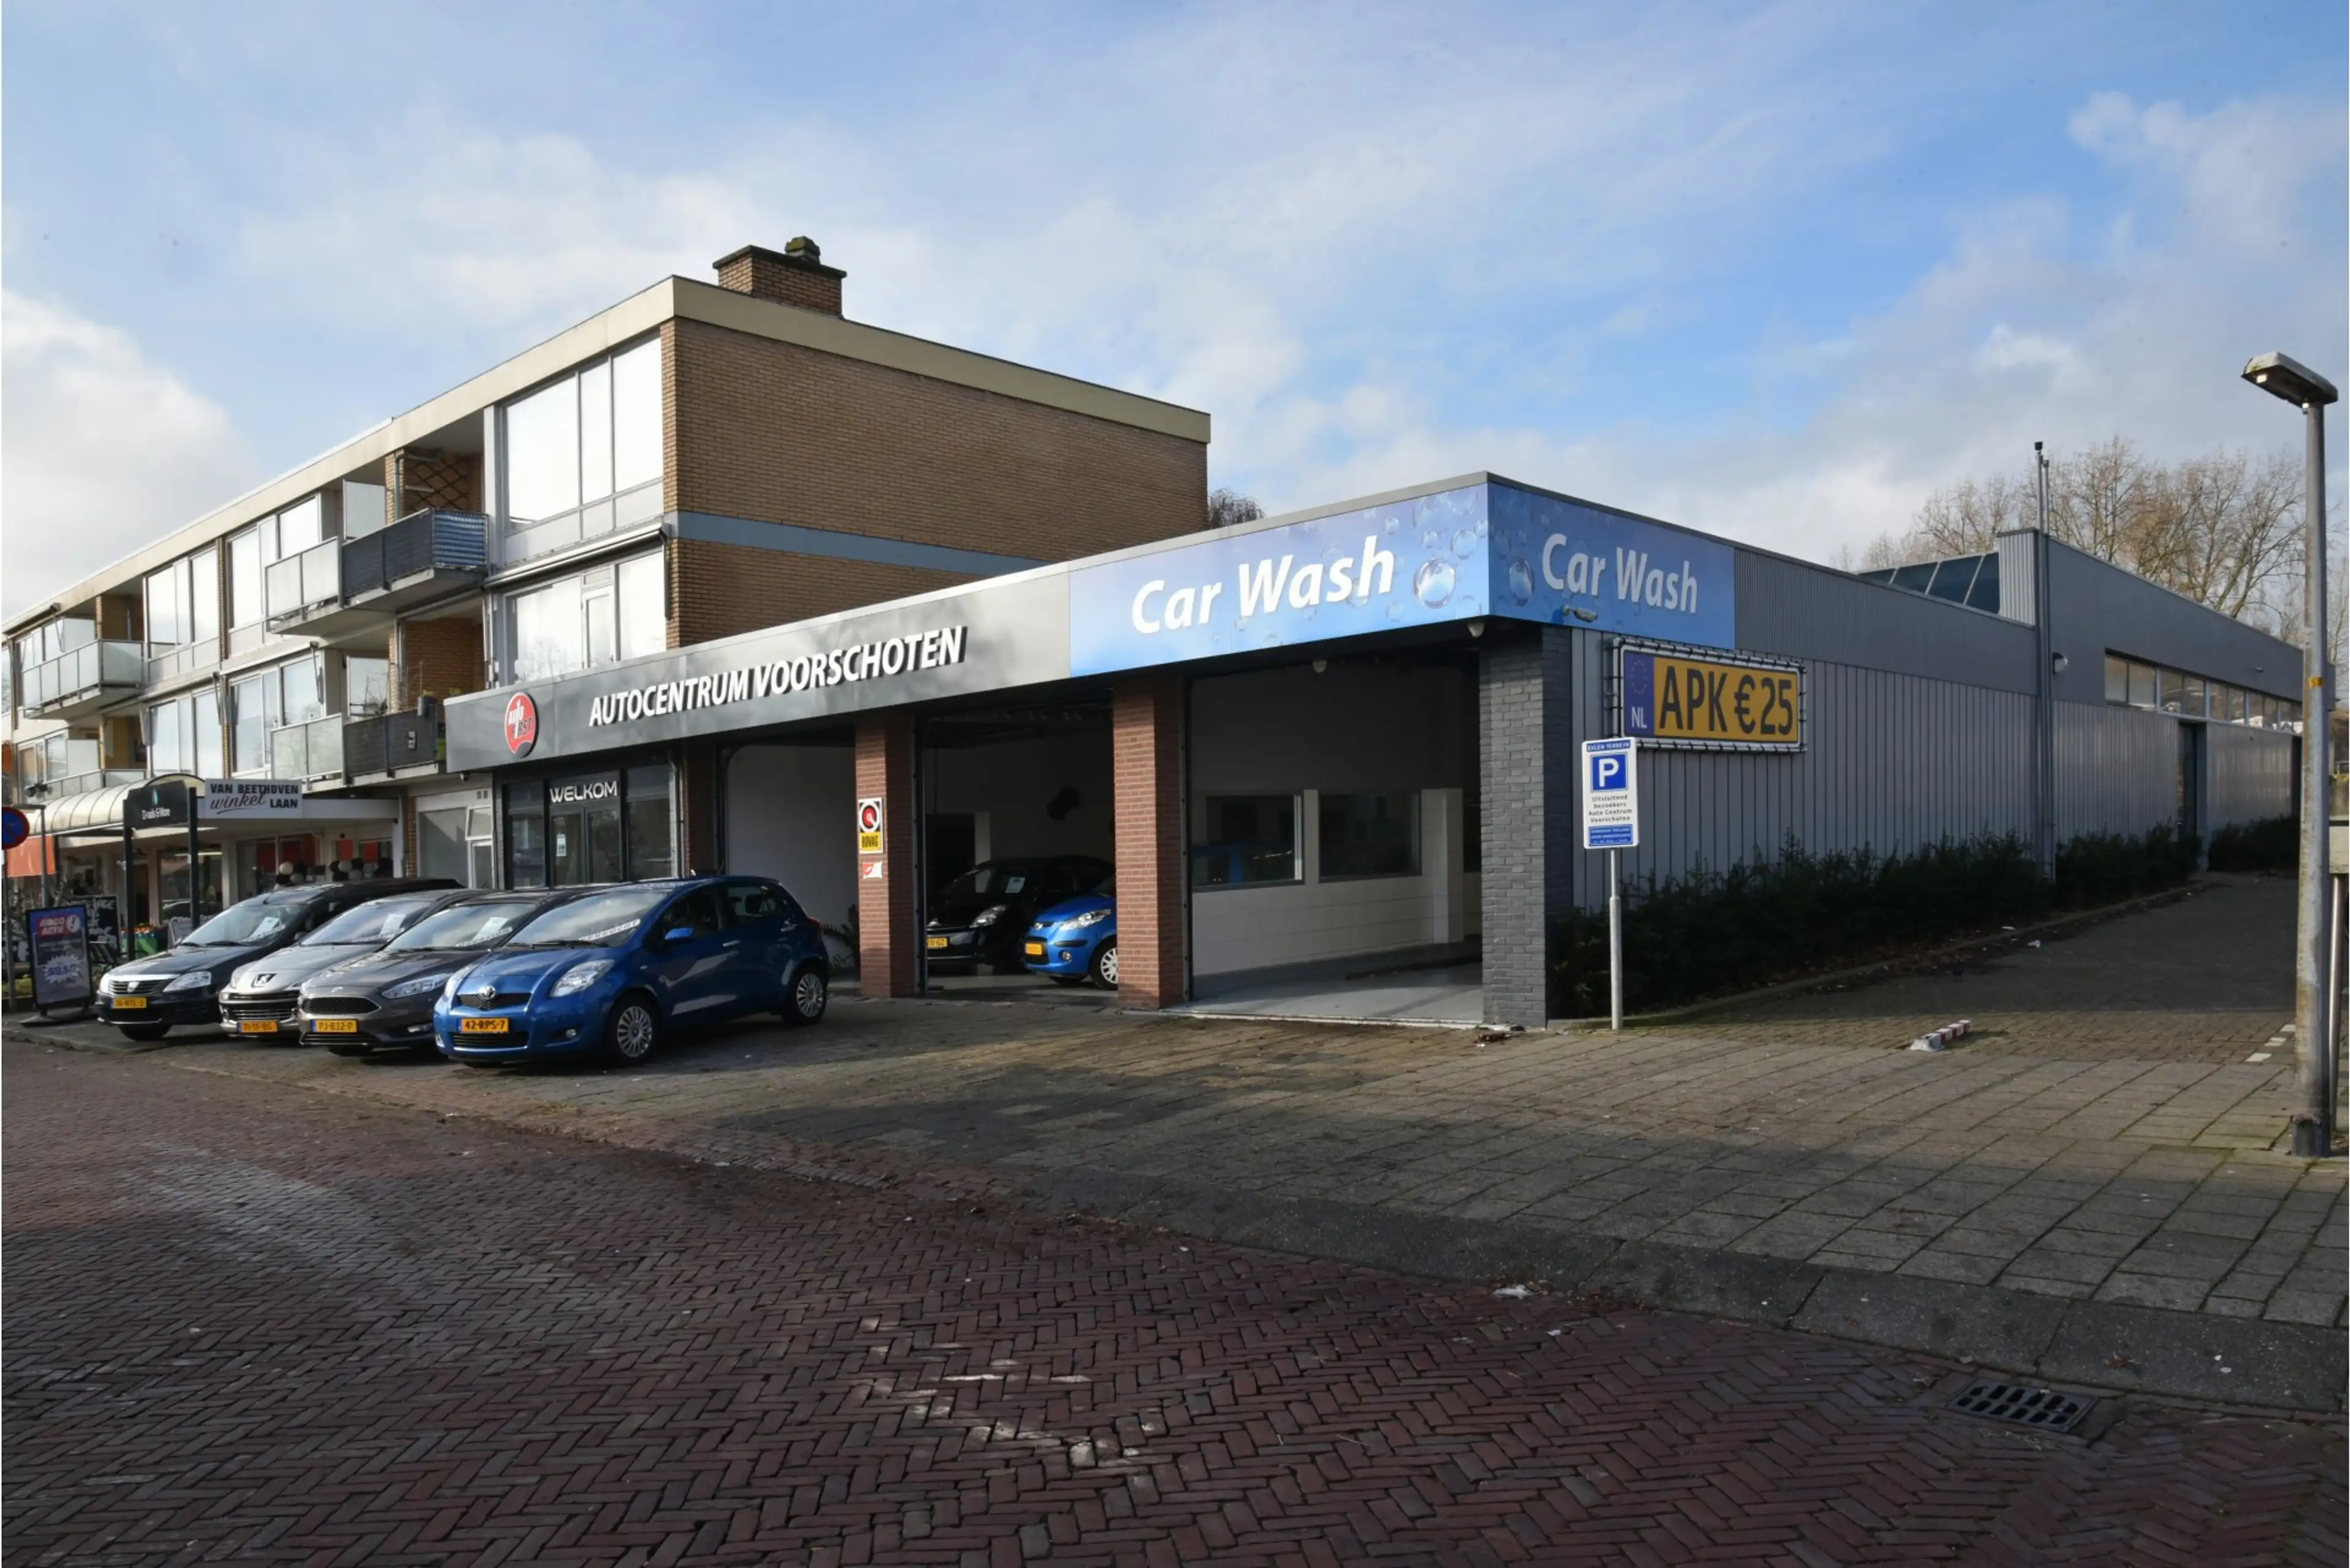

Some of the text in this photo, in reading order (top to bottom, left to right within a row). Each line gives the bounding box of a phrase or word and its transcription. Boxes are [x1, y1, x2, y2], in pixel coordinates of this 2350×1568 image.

[1130, 534, 1395, 634] Car Wash
[1541, 533, 1698, 614] Car Wash
[589, 625, 969, 727] AUTOCENTRUM VOORSCHOTEN
[1659, 666, 1728, 733] APK
[1631, 706, 1647, 729] NL
[1598, 758, 1619, 788] P
[210, 783, 299, 794] VAN BEETHOVEN
[210, 786, 298, 810] winkel LAAN
[550, 780, 617, 804] WELKOM
[318, 1022, 354, 1031] PJ-832-P
[465, 1020, 505, 1030] 42-RPS-7
